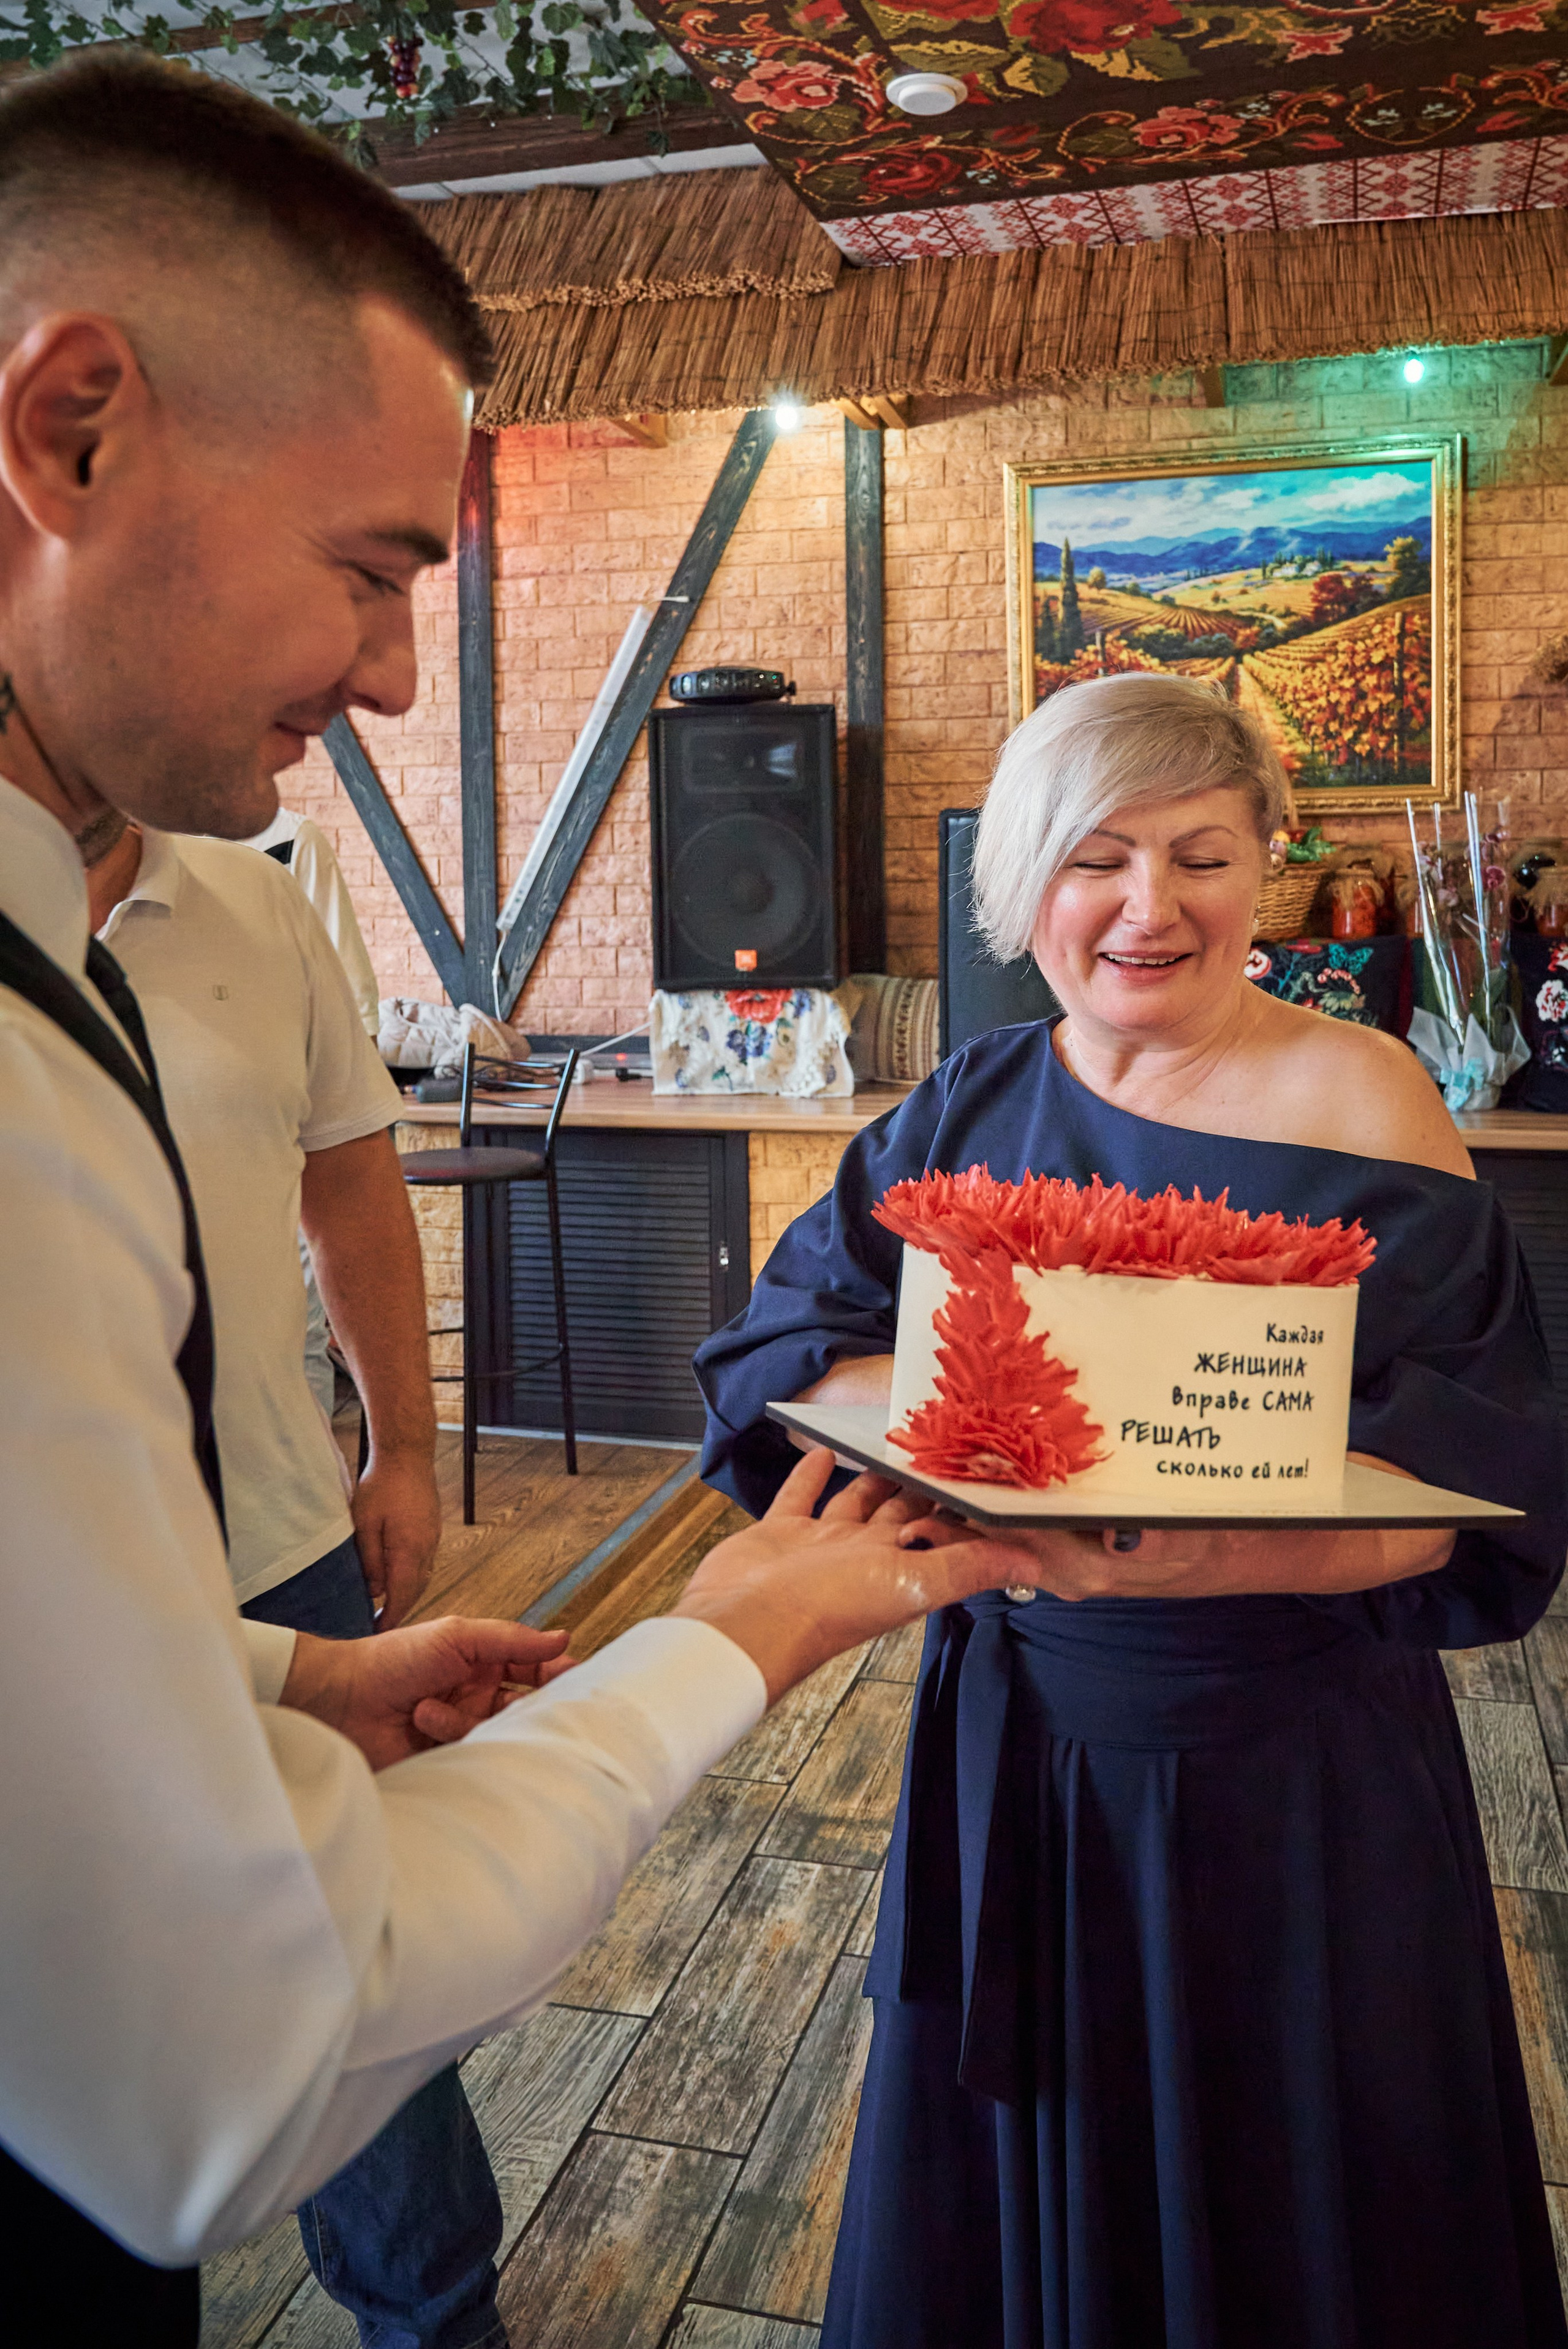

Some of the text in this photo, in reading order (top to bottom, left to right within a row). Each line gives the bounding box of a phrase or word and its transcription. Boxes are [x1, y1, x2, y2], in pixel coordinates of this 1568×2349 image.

[1265, 1322, 1325, 1345] Каждая
[1194, 1352, 1308, 1378] ЖЕНЩИНА
[1262, 1390, 1314, 1412] САМА
[1120, 1419, 1221, 1450] РЕШАТЬ
[1251, 1461, 1271, 1479] ей
[1278, 1457, 1310, 1479] лет!
